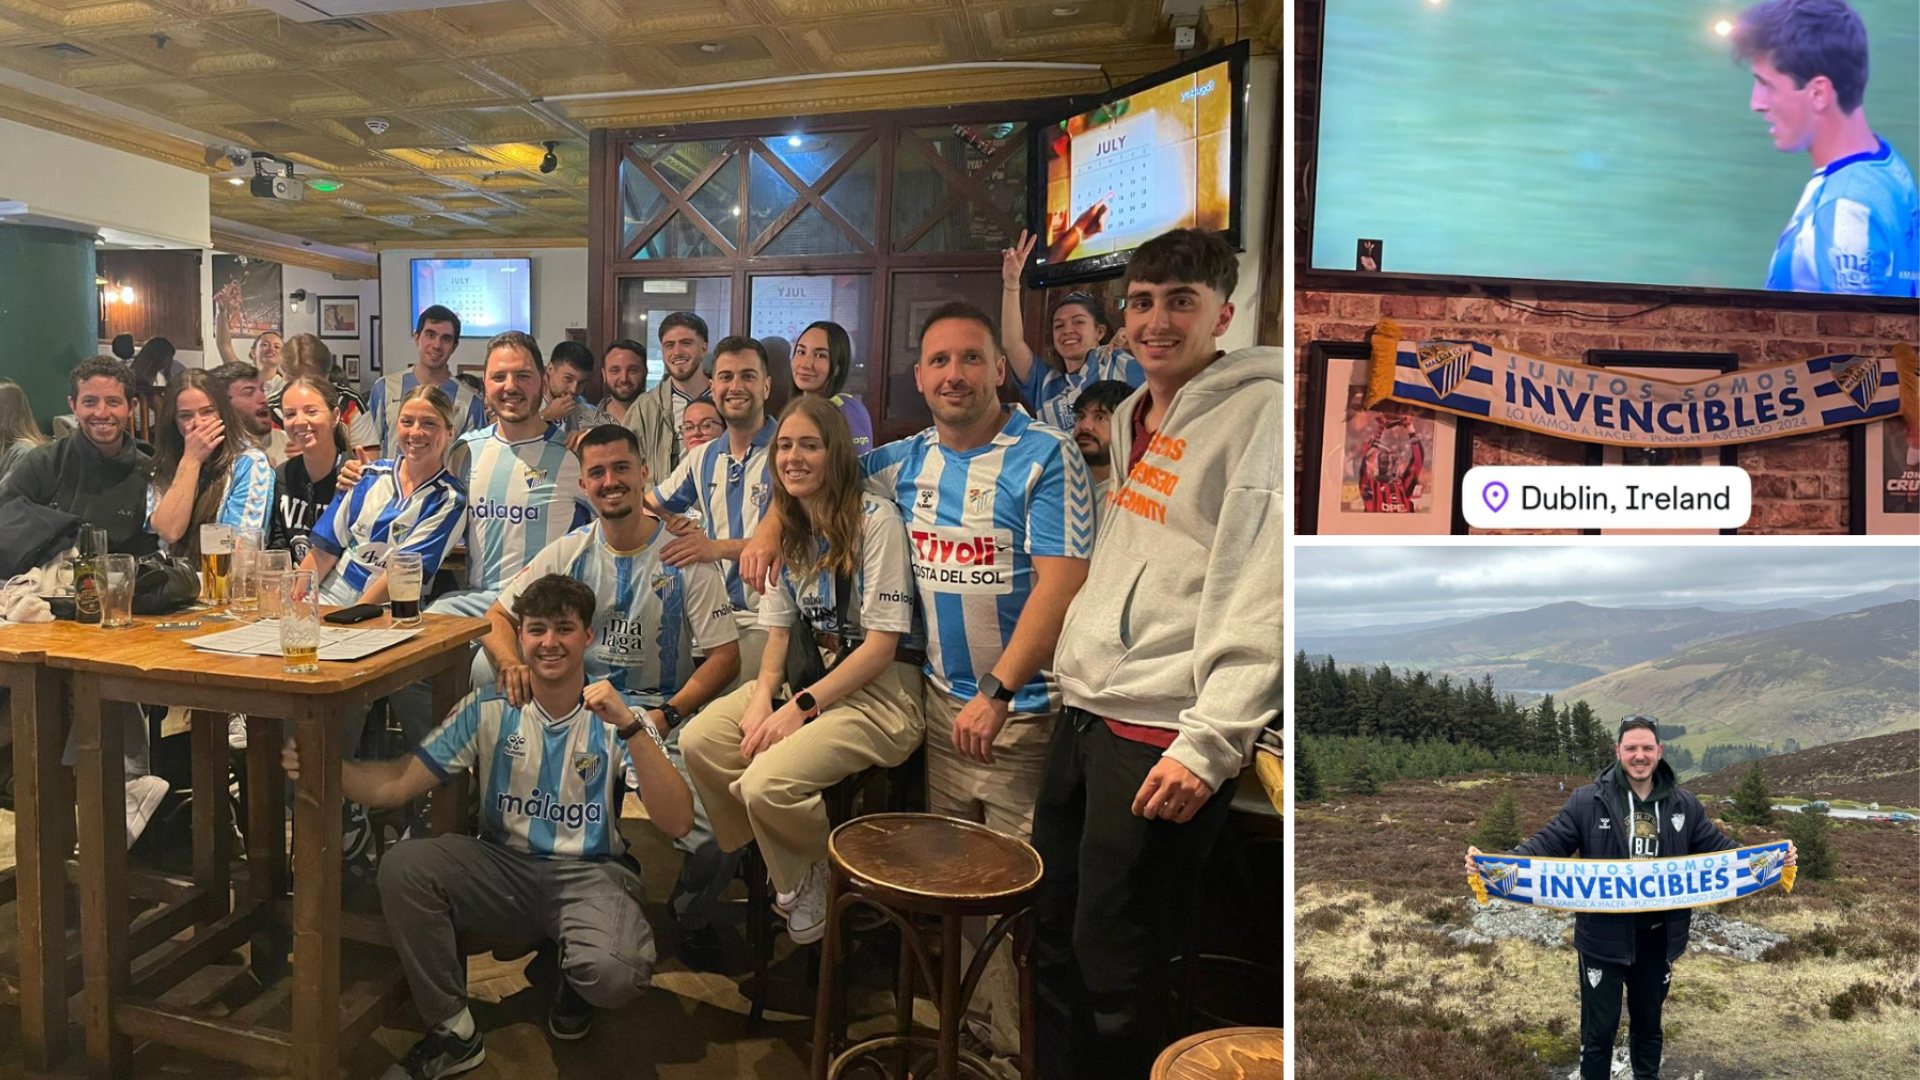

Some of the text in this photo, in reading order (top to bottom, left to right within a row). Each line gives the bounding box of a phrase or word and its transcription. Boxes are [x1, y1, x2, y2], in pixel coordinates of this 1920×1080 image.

[1096, 135, 1126, 156] JULY
[451, 277, 470, 285] JULY
[1507, 356, 1796, 400] JUNTOS SOMOS
[1505, 371, 1805, 434] INVENCIBLES
[1506, 406, 1524, 420] LO
[1529, 411, 1576, 432] VAMOS
[1581, 426, 1590, 435] A
[1594, 429, 1637, 440] HACER
[1713, 424, 1772, 440] ASCENSO
[1777, 417, 1807, 431] 2024
[911, 530, 994, 566] Tivoli
[941, 569, 967, 584] DEL
[971, 571, 1005, 585] SOL
[610, 615, 642, 636] má
[601, 627, 642, 654] laga
[1541, 855, 1729, 875] JUNTOS SOMOS
[1540, 867, 1729, 898] INVENCIBLES
